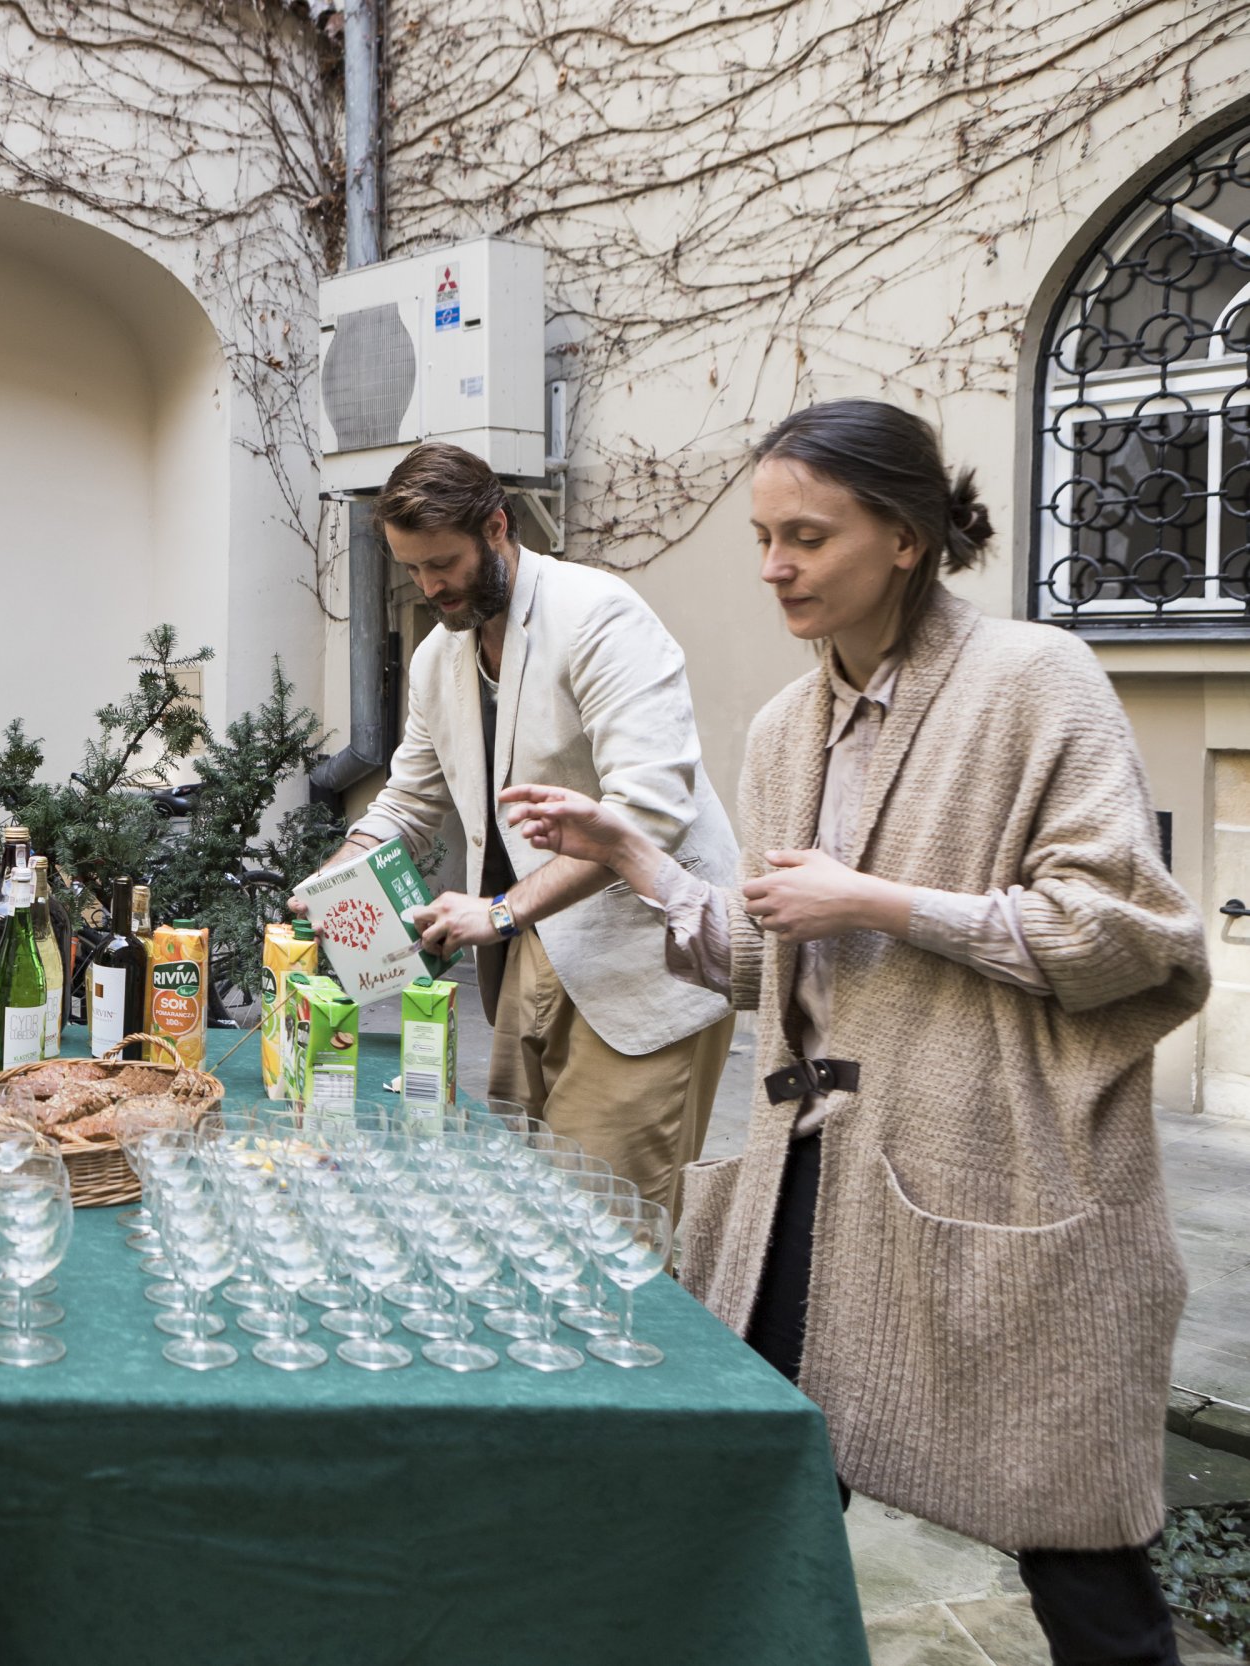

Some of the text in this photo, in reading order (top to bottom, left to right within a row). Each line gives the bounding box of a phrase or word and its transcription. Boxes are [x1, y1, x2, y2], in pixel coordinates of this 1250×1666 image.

[153, 969, 198, 985] RIVIVA
[160, 997, 188, 1010] SOK
[10, 1013, 39, 1032] CYDR
